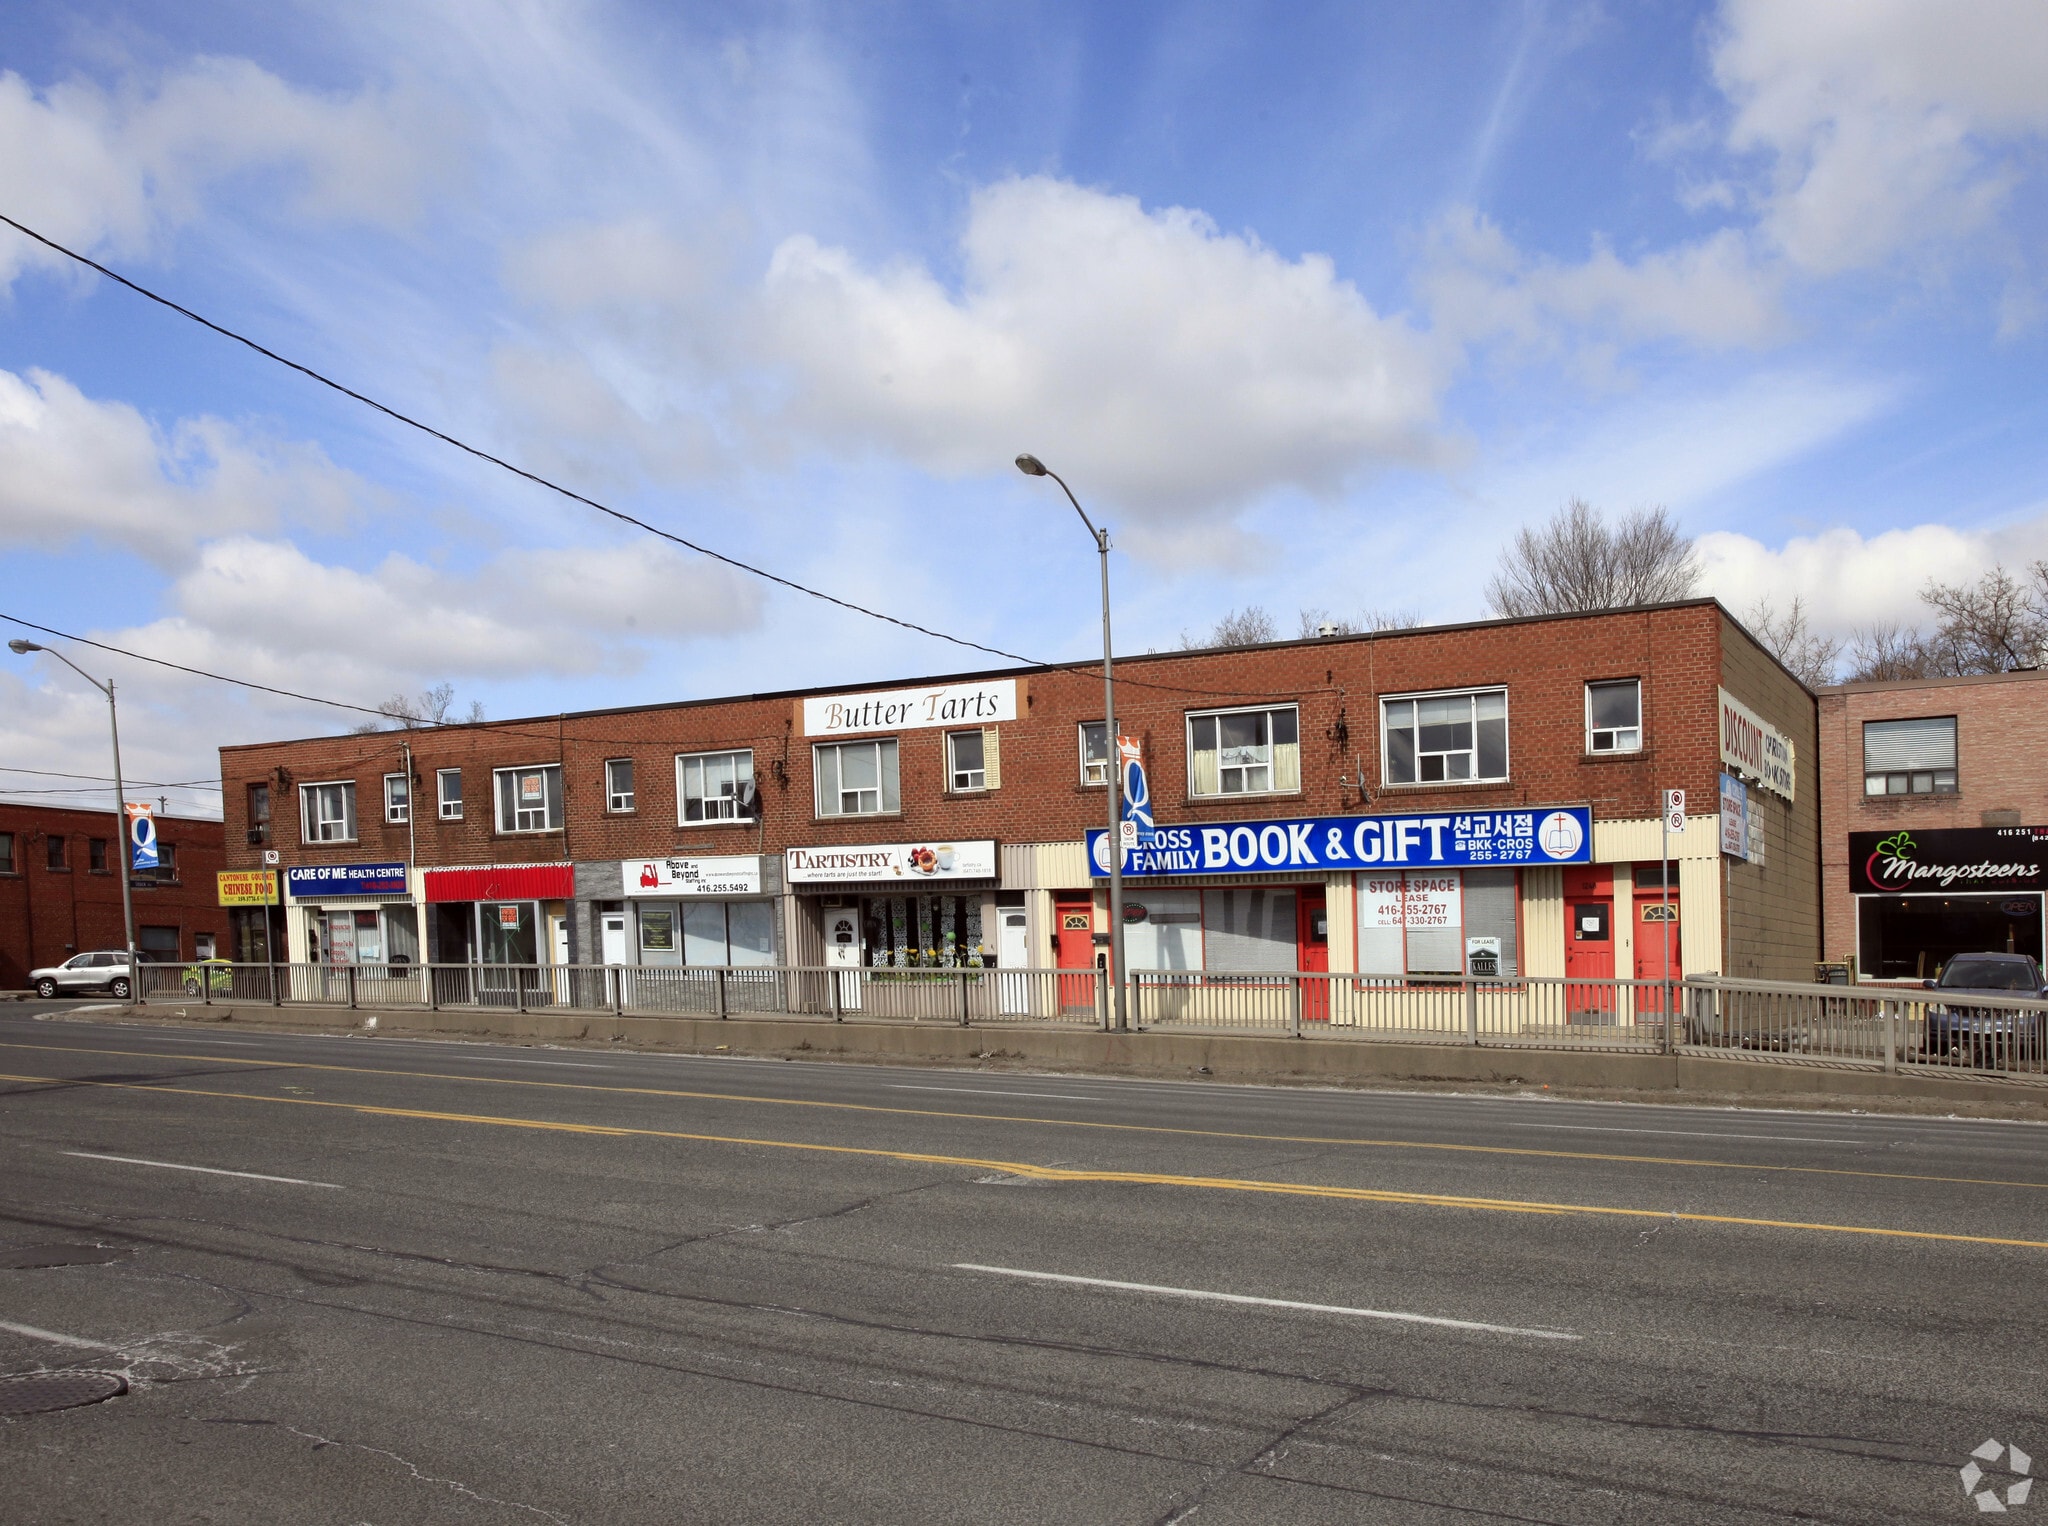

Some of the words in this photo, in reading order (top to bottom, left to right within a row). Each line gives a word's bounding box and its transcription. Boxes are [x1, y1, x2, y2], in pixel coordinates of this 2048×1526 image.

[825, 701, 913, 729] Butter
[922, 689, 999, 721] Tarts
[1724, 704, 1762, 772] DISCOUNT
[1453, 814, 1533, 839] 선교서점
[2015, 828, 2031, 836] 251
[1134, 829, 1192, 850] OSS
[1200, 823, 1319, 868] BOOK
[1325, 827, 1351, 860] &
[1353, 817, 1450, 862] GIFT
[1468, 838, 1534, 851] BKK-CROS
[789, 850, 893, 869] TARTISTRY
[1132, 850, 1200, 871] FAMILY
[1470, 850, 1532, 860] 255-2767
[666, 860, 689, 869] Above
[219, 873, 249, 881] CANTONESE
[251, 872, 275, 880] GOUMET
[291, 869, 317, 880] CARE
[318, 869, 331, 880] OF
[332, 868, 347, 880] ME
[348, 869, 375, 879] HEALTH
[376, 868, 405, 878] CENTRE
[671, 869, 699, 880] Beyond
[846, 871, 858, 879] just
[1883, 857, 2040, 887] Mangosteens
[223, 883, 253, 895] CHINESE
[255, 882, 273, 895] FOD
[697, 883, 748, 892] 416.255.5492
[1369, 880, 1411, 893] STORE
[1414, 879, 1455, 892] SPACE
[1392, 916, 1447, 925] 64-330-2767
